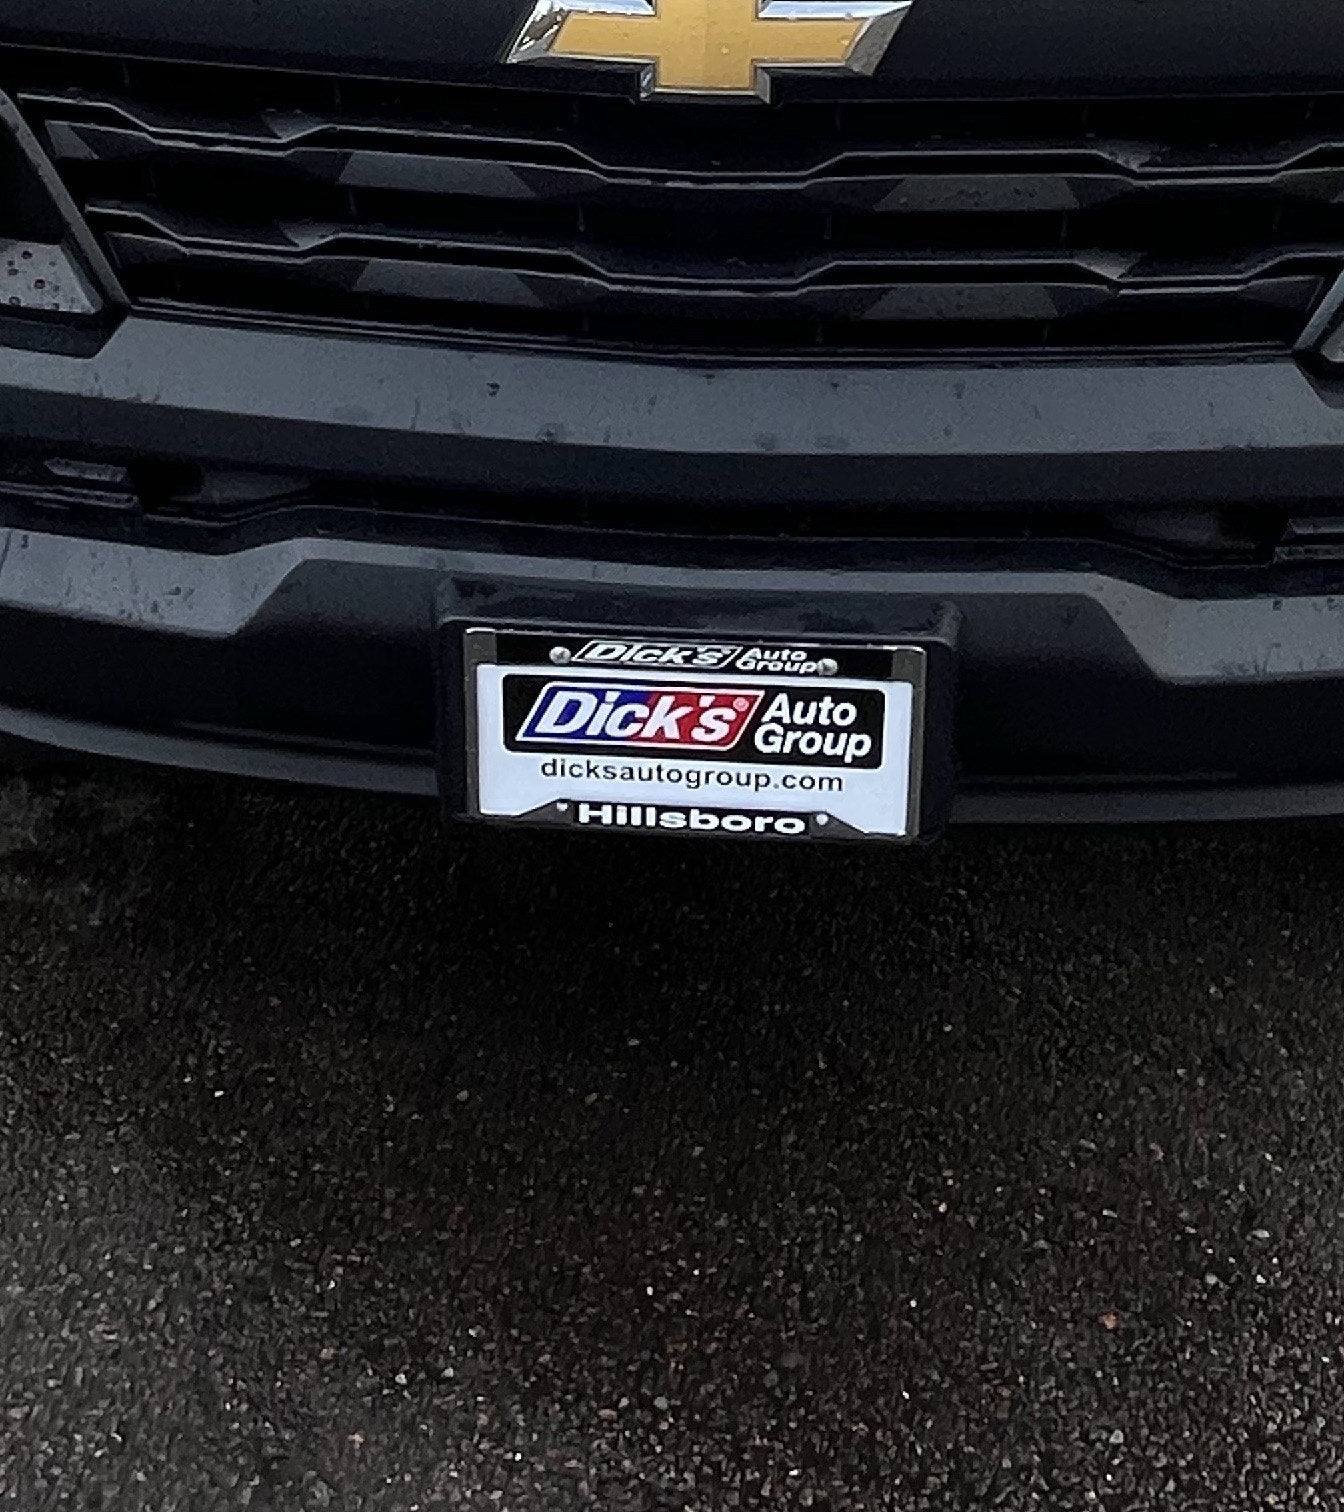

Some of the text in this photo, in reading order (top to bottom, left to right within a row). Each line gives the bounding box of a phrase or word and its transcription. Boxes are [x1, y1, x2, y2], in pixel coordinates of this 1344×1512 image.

[735, 658, 817, 675] Group
[747, 647, 807, 662] Auto
[534, 689, 857, 743] Dick's Auto
[754, 722, 872, 764] Group
[540, 757, 844, 792] dicksautogroup.com
[577, 803, 807, 835] Hillsboro
